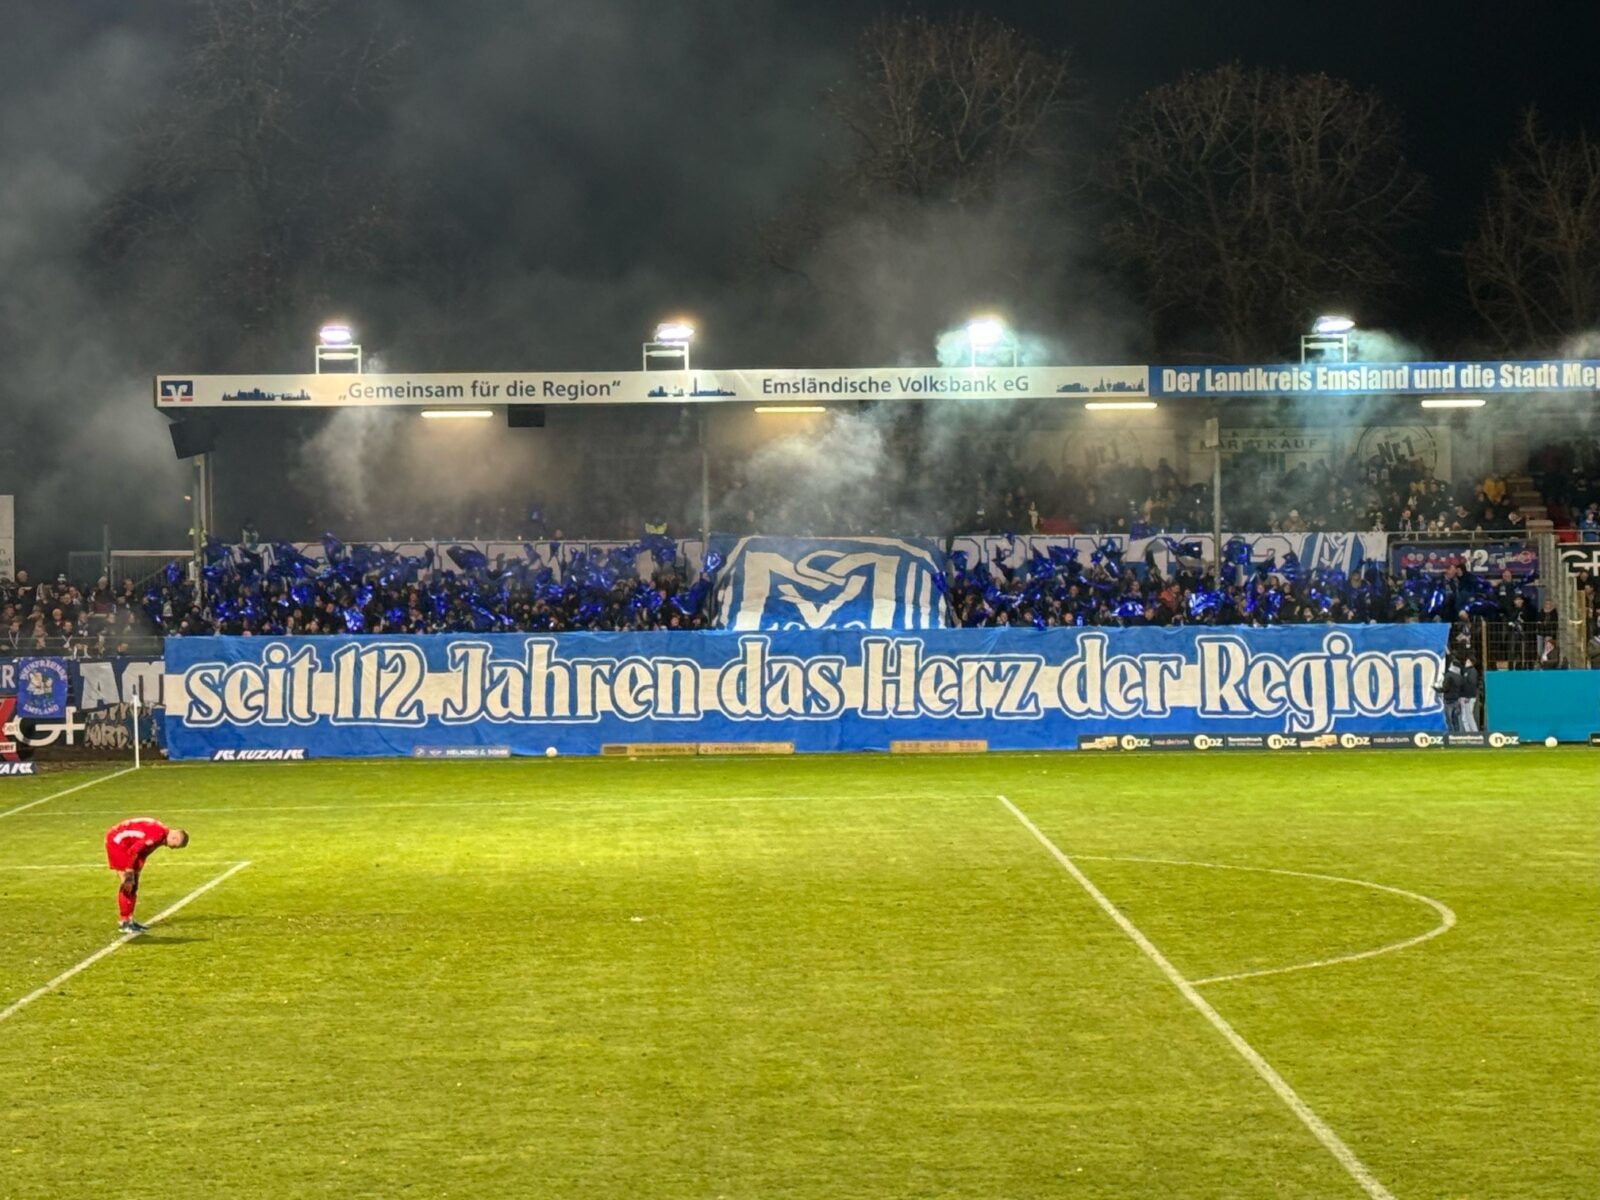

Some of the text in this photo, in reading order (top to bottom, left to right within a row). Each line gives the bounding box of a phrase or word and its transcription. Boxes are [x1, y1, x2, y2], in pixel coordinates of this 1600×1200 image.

[762, 375, 1029, 394] Emsländische Volksbank eG
[1162, 368, 1200, 392] Der
[1204, 366, 1311, 391] Landkreis
[1316, 365, 1409, 391] Emsland
[1413, 364, 1456, 389] und
[1460, 364, 1496, 388] die
[1500, 363, 1559, 387] Stadt
[338, 381, 464, 401] „Gemeinsam
[470, 380, 501, 398] für
[505, 379, 536, 397] die
[184, 631, 1446, 733] seit 112 Jahren das Herz der Region
[1124, 736, 1150, 748] noz
[1197, 736, 1223, 748] noz
[1270, 736, 1297, 748] noz
[1343, 735, 1370, 747] noz
[1416, 735, 1443, 747] noz
[1491, 734, 1519, 747] noz
[236, 749, 284, 760] KUZKA
